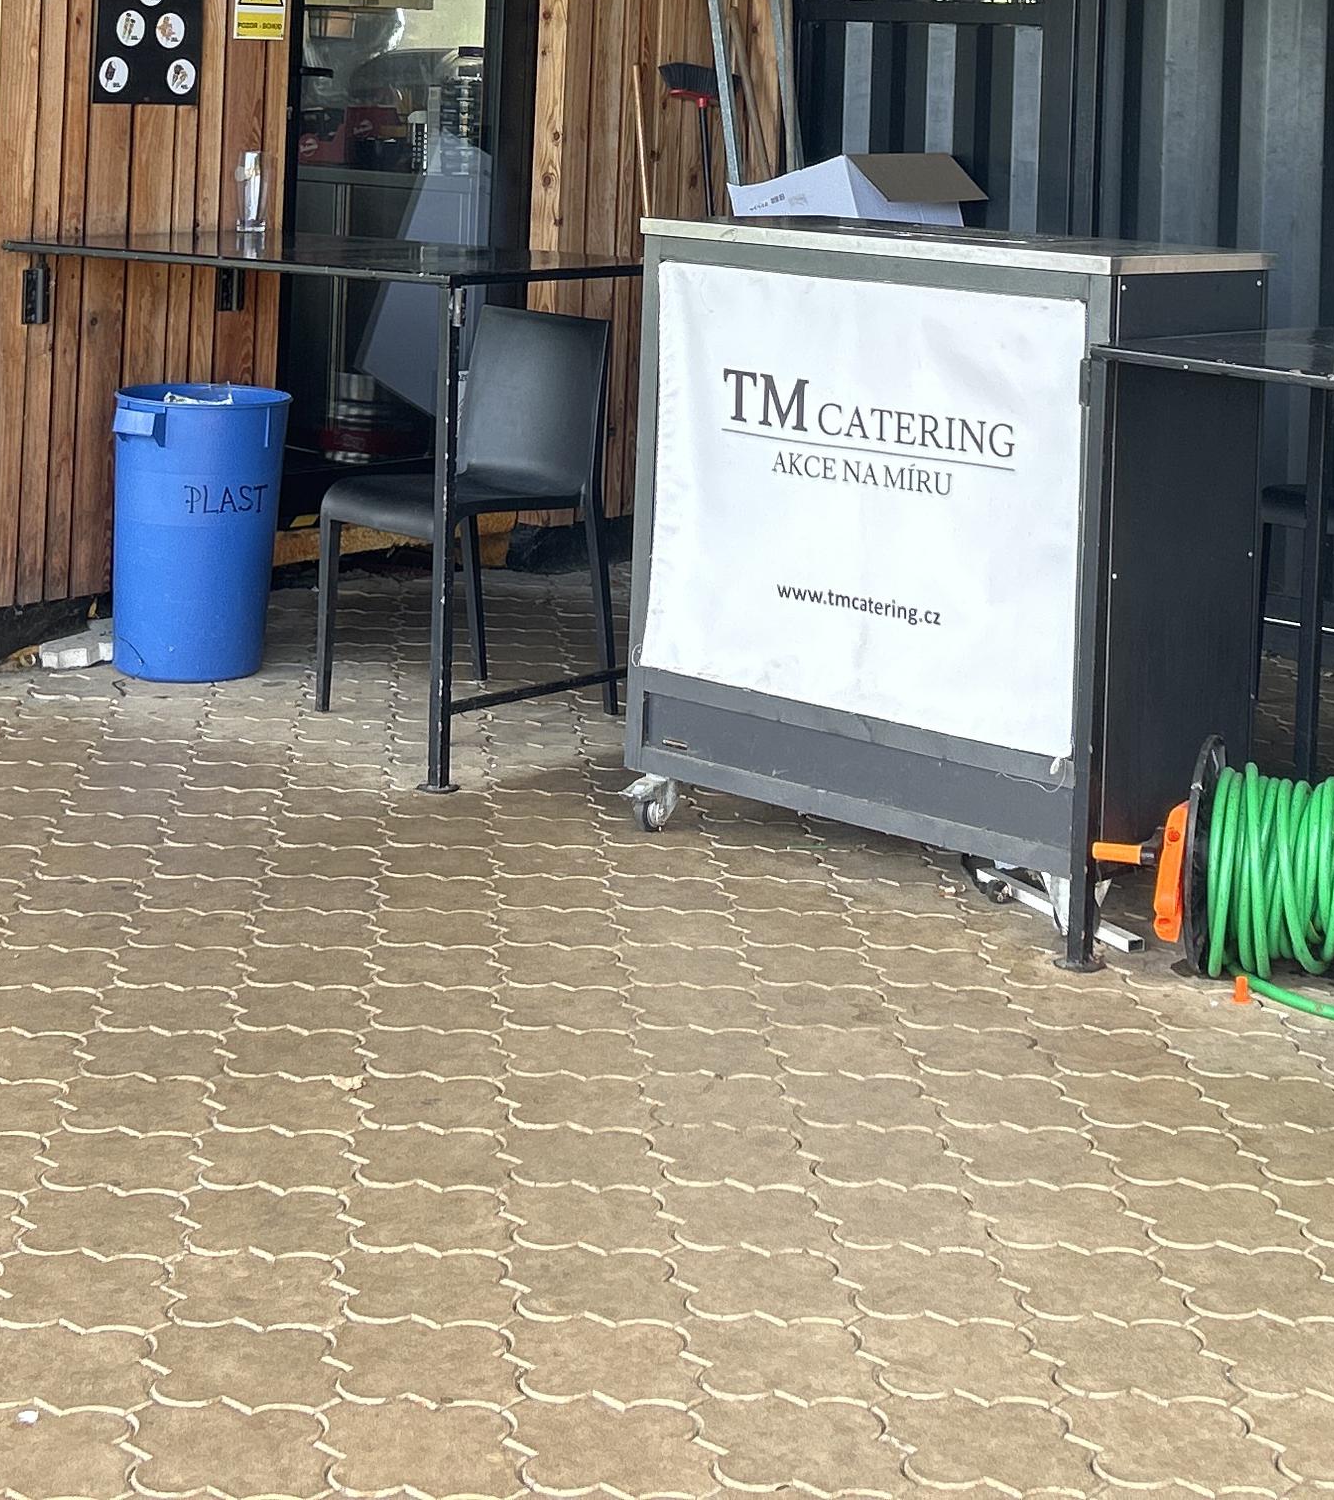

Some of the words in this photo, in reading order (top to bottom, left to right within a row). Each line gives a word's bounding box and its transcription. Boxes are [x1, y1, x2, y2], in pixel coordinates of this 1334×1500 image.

[723, 368, 809, 432] TM
[817, 402, 1015, 458] CATERING
[771, 450, 837, 480] AKCE
[841, 459, 879, 486] NA
[883, 463, 952, 496] MÍRU
[184, 483, 269, 514] PLAST
[777, 581, 941, 626] www.tmcatering.cz
